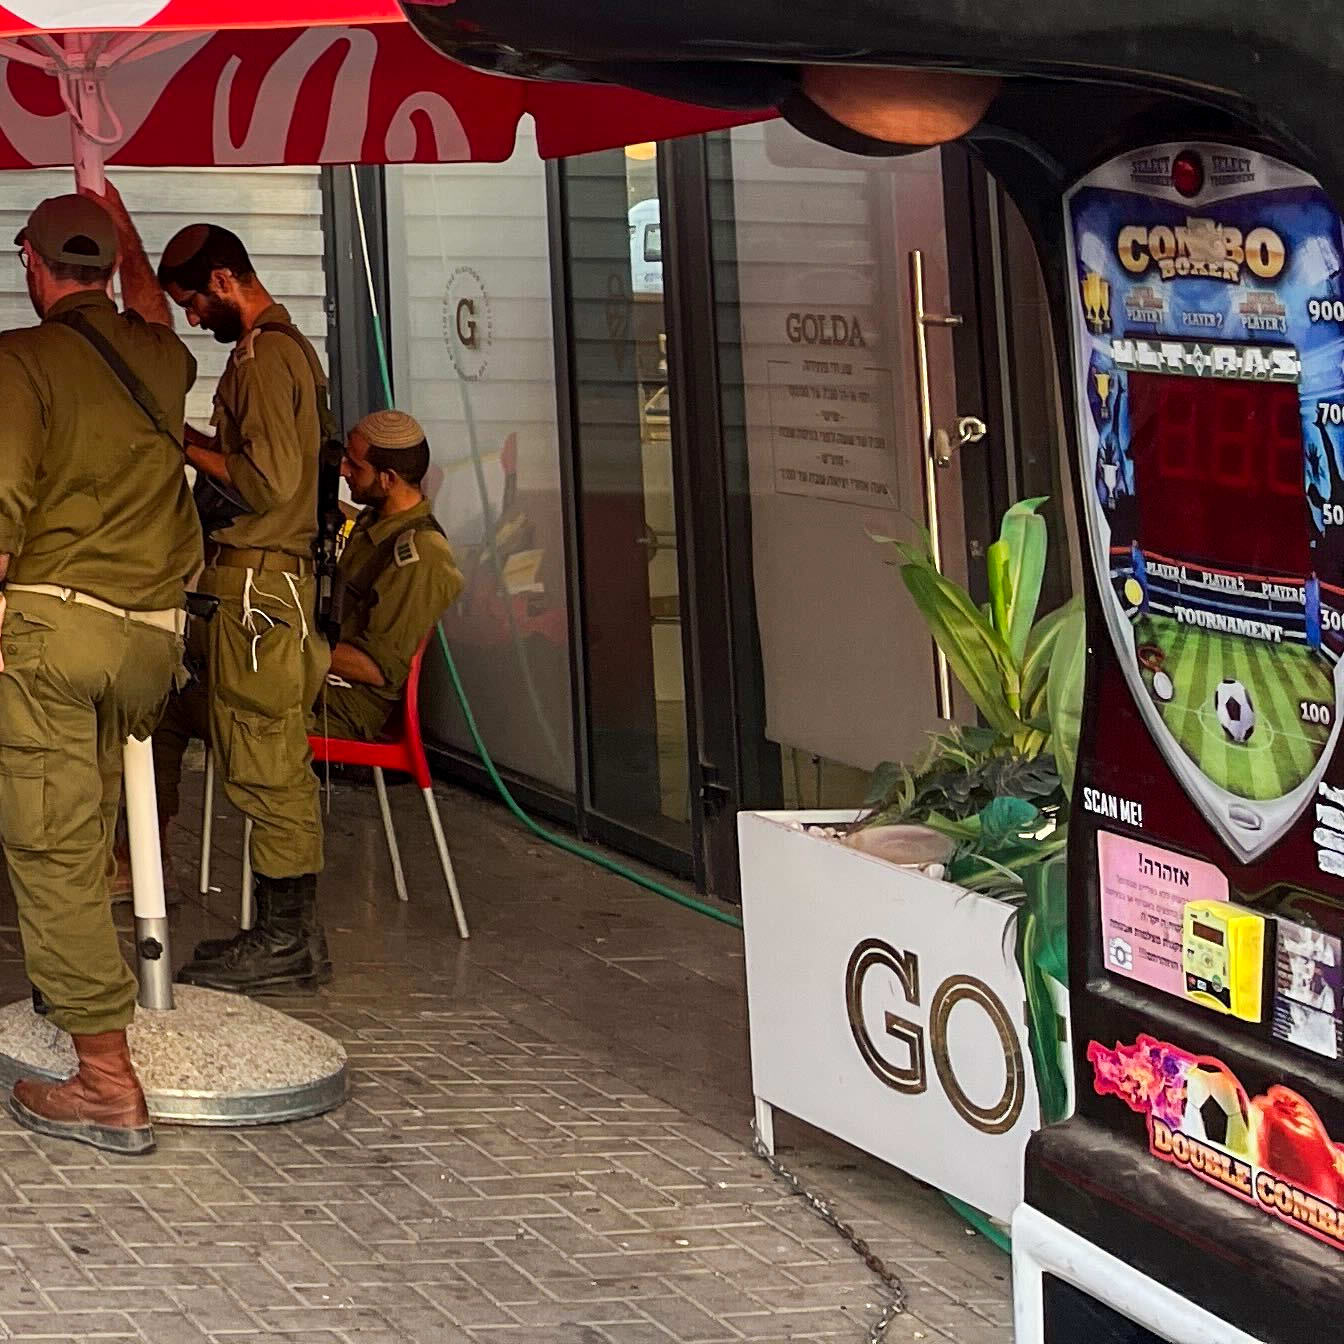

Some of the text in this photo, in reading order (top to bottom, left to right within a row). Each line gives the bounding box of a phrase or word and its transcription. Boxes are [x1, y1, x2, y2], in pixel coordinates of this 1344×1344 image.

[1158, 258, 1239, 282] BOXER
[1127, 309, 1157, 323] PLAYER
[1183, 312, 1215, 327] PLAYER
[1240, 315, 1278, 331] PLAYER
[1309, 300, 1344, 323] 900
[456, 298, 477, 349] G
[786, 313, 866, 348] GOLDA
[1319, 402, 1344, 425] 70
[1146, 562, 1180, 580] PLAYER
[1202, 572, 1238, 591] PLAYER
[1262, 582, 1298, 602] PLAYER
[1174, 606, 1283, 643] TOURNAMENT
[1320, 609, 1344, 631] 30
[1301, 702, 1330, 725] 100
[1083, 787, 1143, 827] SCAN ME!
[1138, 853, 1190, 886] אזהרה!
[845, 937, 1025, 1135] GO
[1153, 1115, 1253, 1198] DOUBLE
